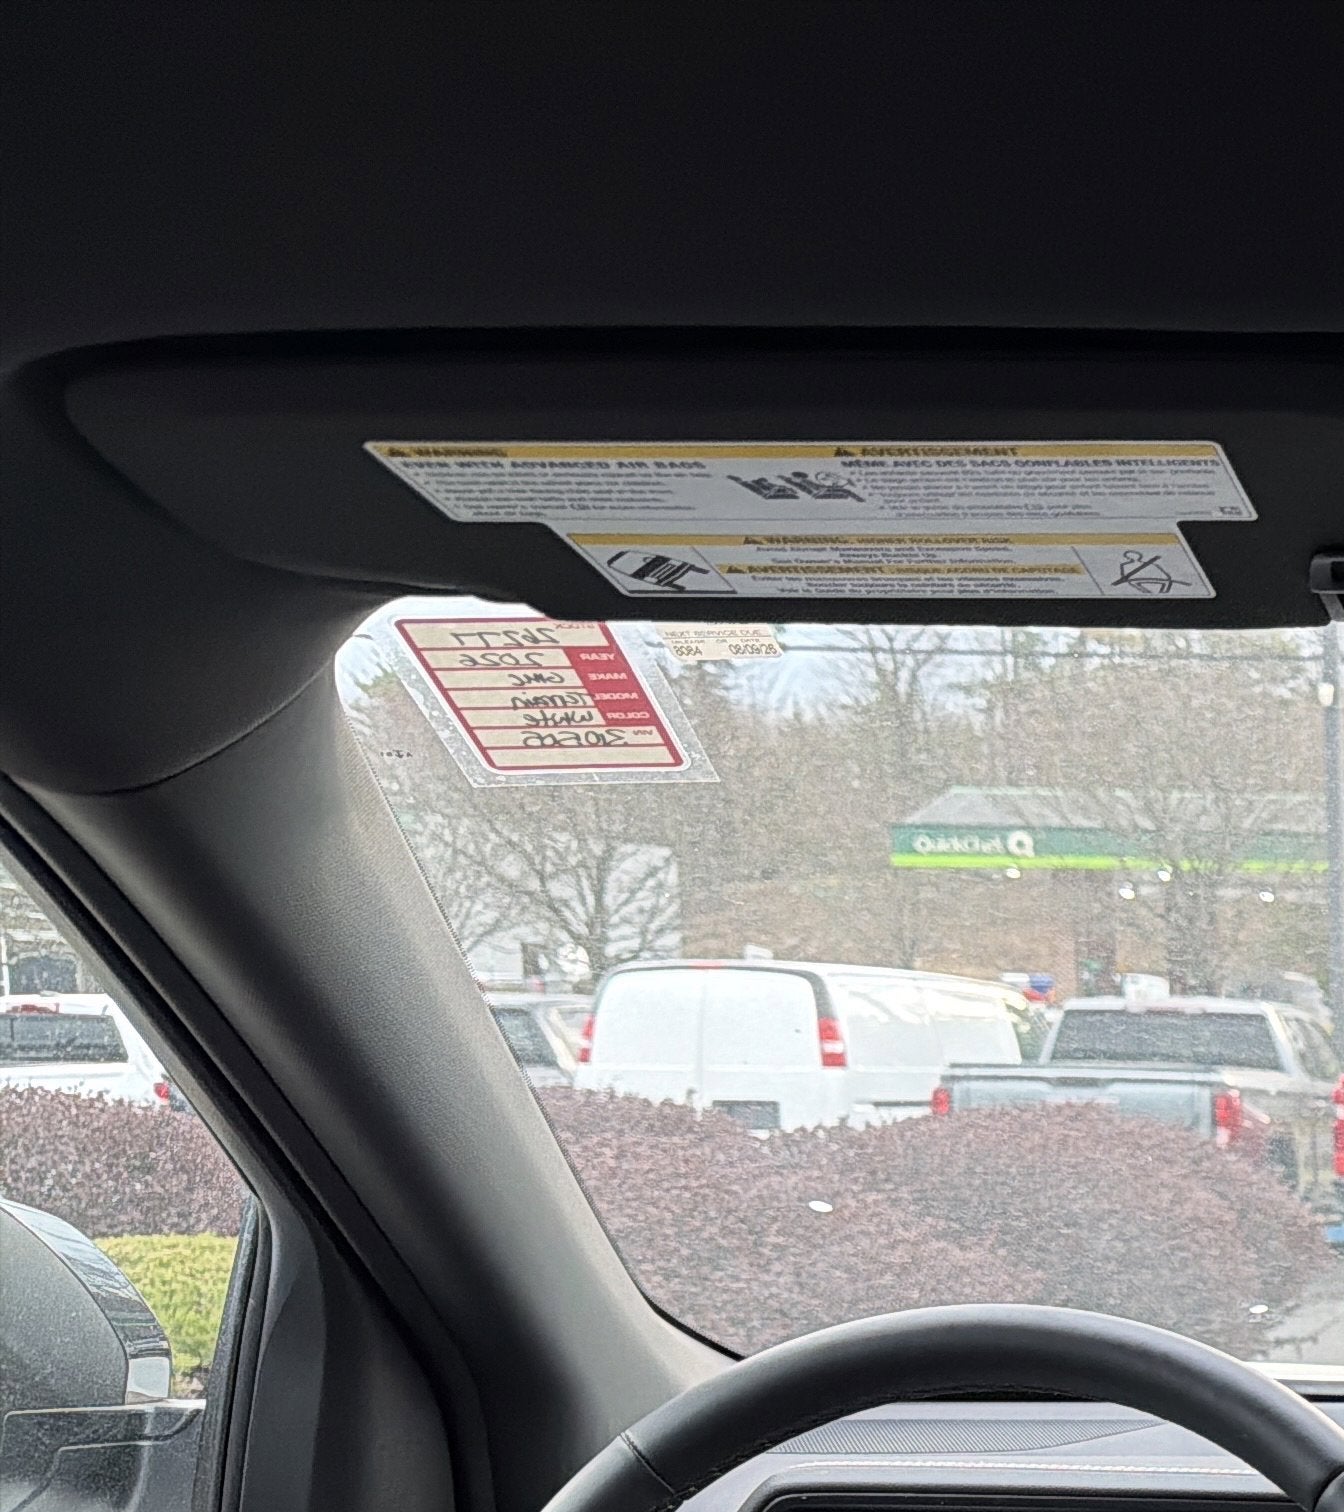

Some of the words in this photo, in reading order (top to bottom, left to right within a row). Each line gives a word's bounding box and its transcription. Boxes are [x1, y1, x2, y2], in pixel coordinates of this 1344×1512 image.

[453, 461, 505, 470] WITH
[510, 461, 610, 470] ADVANCED
[616, 461, 649, 470] AIR
[653, 461, 706, 470] BAGS
[935, 459, 968, 468] DES
[969, 459, 1013, 468] SACS
